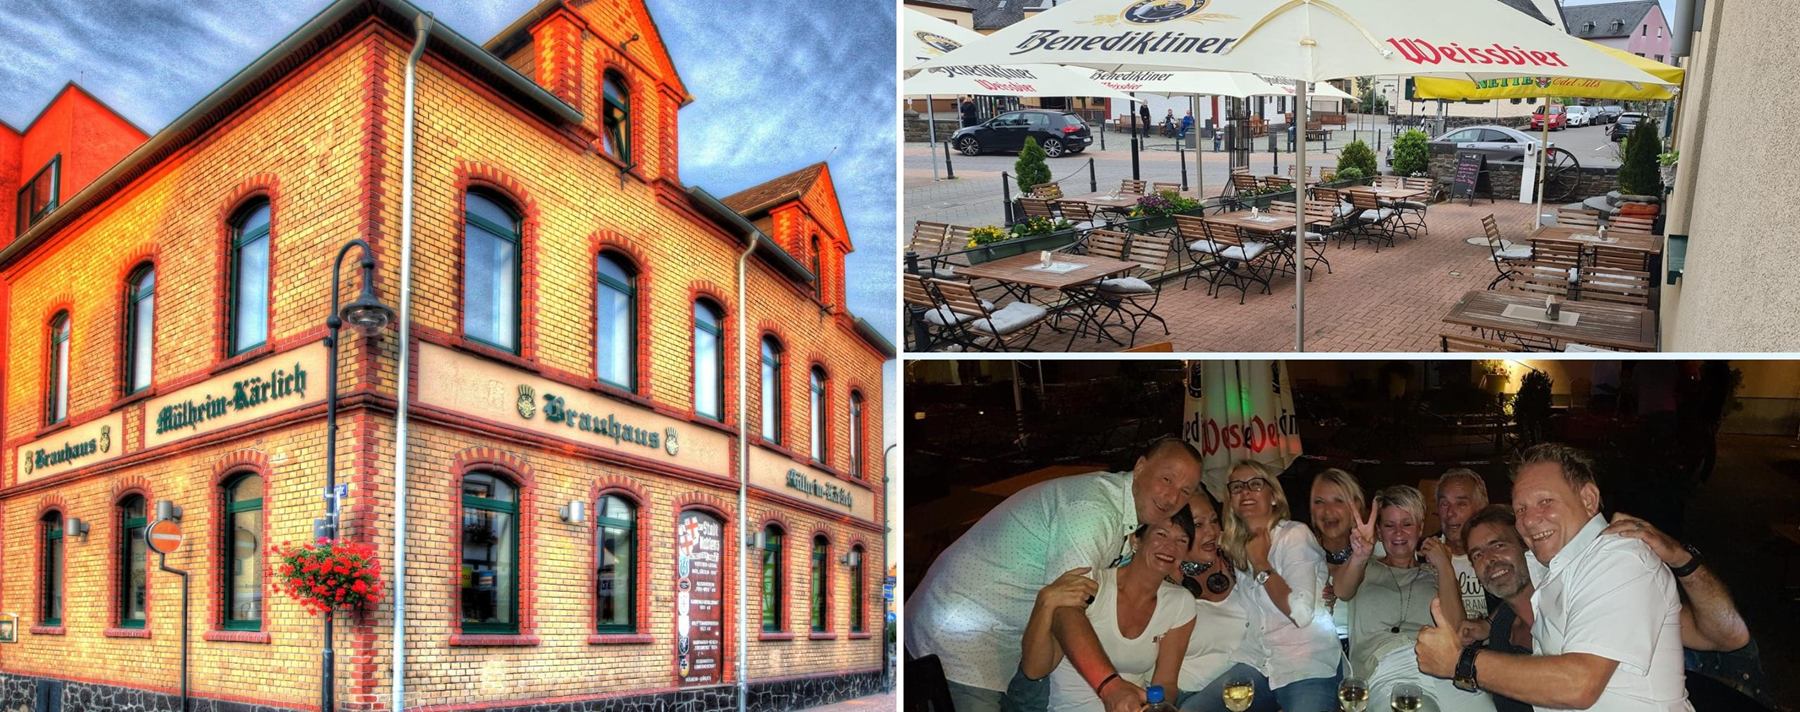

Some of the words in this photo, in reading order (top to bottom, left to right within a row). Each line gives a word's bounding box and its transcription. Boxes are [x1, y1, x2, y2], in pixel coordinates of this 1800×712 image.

[1009, 30, 1238, 55] Benediktiner
[1386, 37, 1568, 67] Weissbier
[156, 362, 307, 435] Mülheim-Kärlich
[543, 393, 660, 449] Brauhaus
[35, 436, 97, 470] Brauhaus
